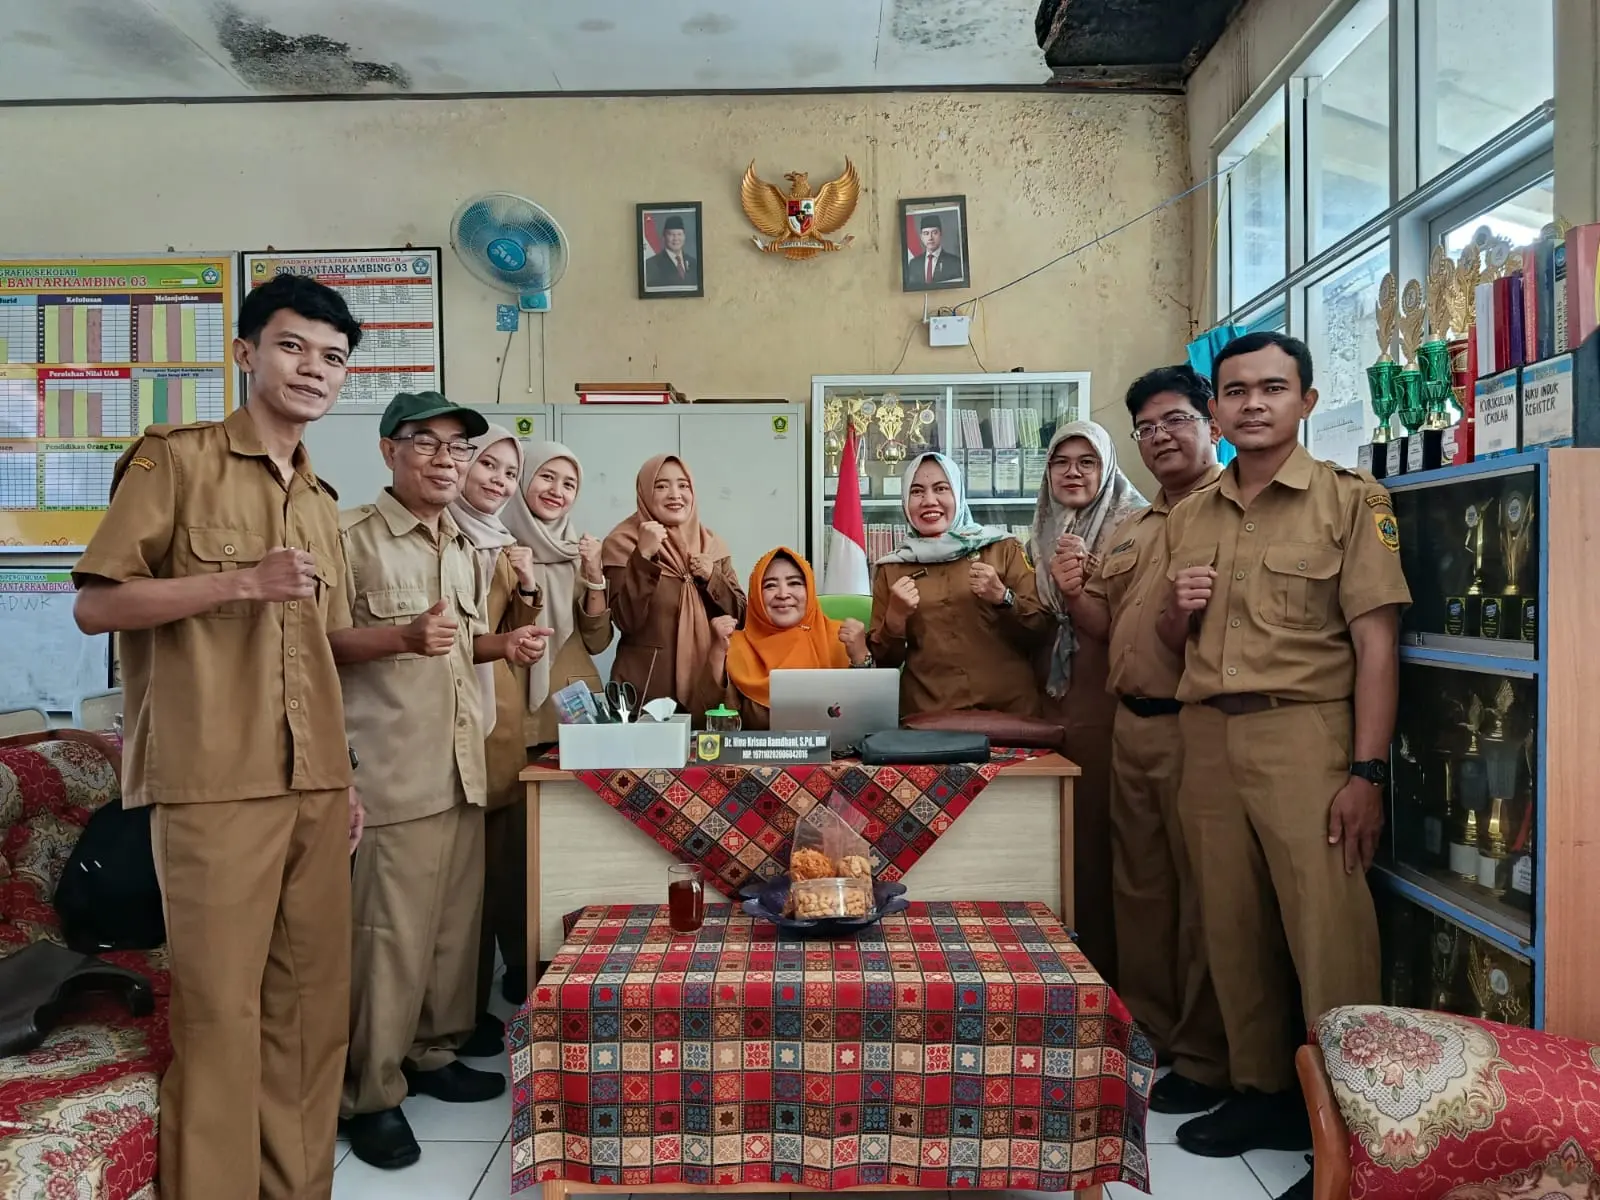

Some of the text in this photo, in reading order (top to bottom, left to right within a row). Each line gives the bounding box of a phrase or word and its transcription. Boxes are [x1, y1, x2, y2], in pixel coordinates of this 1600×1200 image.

[34, 268, 77, 276] SEKOLAH
[275, 263, 408, 275] SDN BANTARKAMBING 03
[7, 276, 126, 288] BANTARKAMBING
[131, 276, 147, 287] 03
[155, 295, 199, 303] Melanjutkan
[87, 443, 109, 451] Orang
